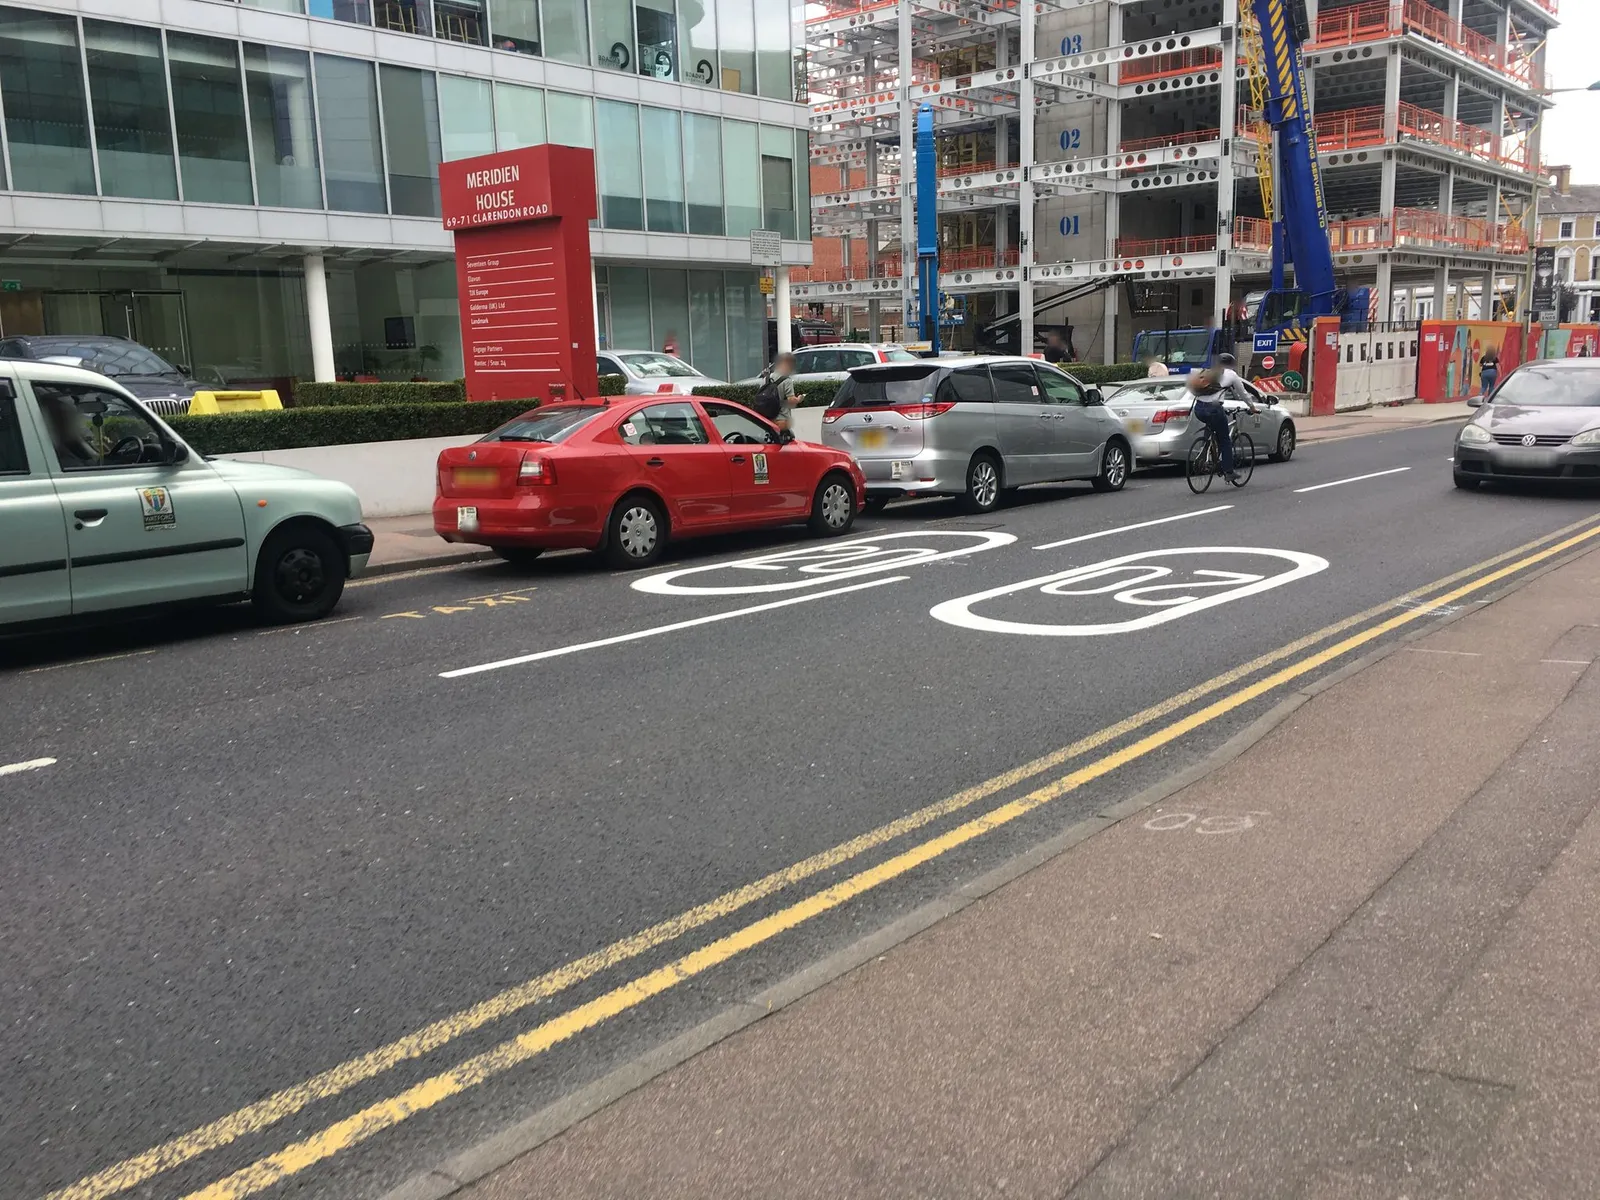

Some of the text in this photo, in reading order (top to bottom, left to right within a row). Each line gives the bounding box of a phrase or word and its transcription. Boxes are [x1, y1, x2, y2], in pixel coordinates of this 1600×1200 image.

[1061, 34, 1082, 56] 03
[1295, 47, 1303, 68] KLN
[1298, 70, 1309, 110] CRANES
[1060, 128, 1081, 150] 02
[466, 165, 520, 189] MERIDIEN
[1311, 161, 1323, 208] SERVICES
[476, 190, 516, 211] HOUSE
[446, 204, 548, 227] 69-71 CLARENDON ROAD
[1059, 216, 1080, 236] 01
[1317, 210, 1326, 228] LTD
[467, 259, 499, 268] Seventeen Group
[476, 288, 488, 297] Europe
[488, 302, 498, 310] (UK)
[473, 346, 486, 354] Engage
[1284, 376, 1300, 389] GO
[732, 546, 939, 573] 20
[1040, 565, 1265, 606] 20
[381, 595, 531, 619] TAXI
